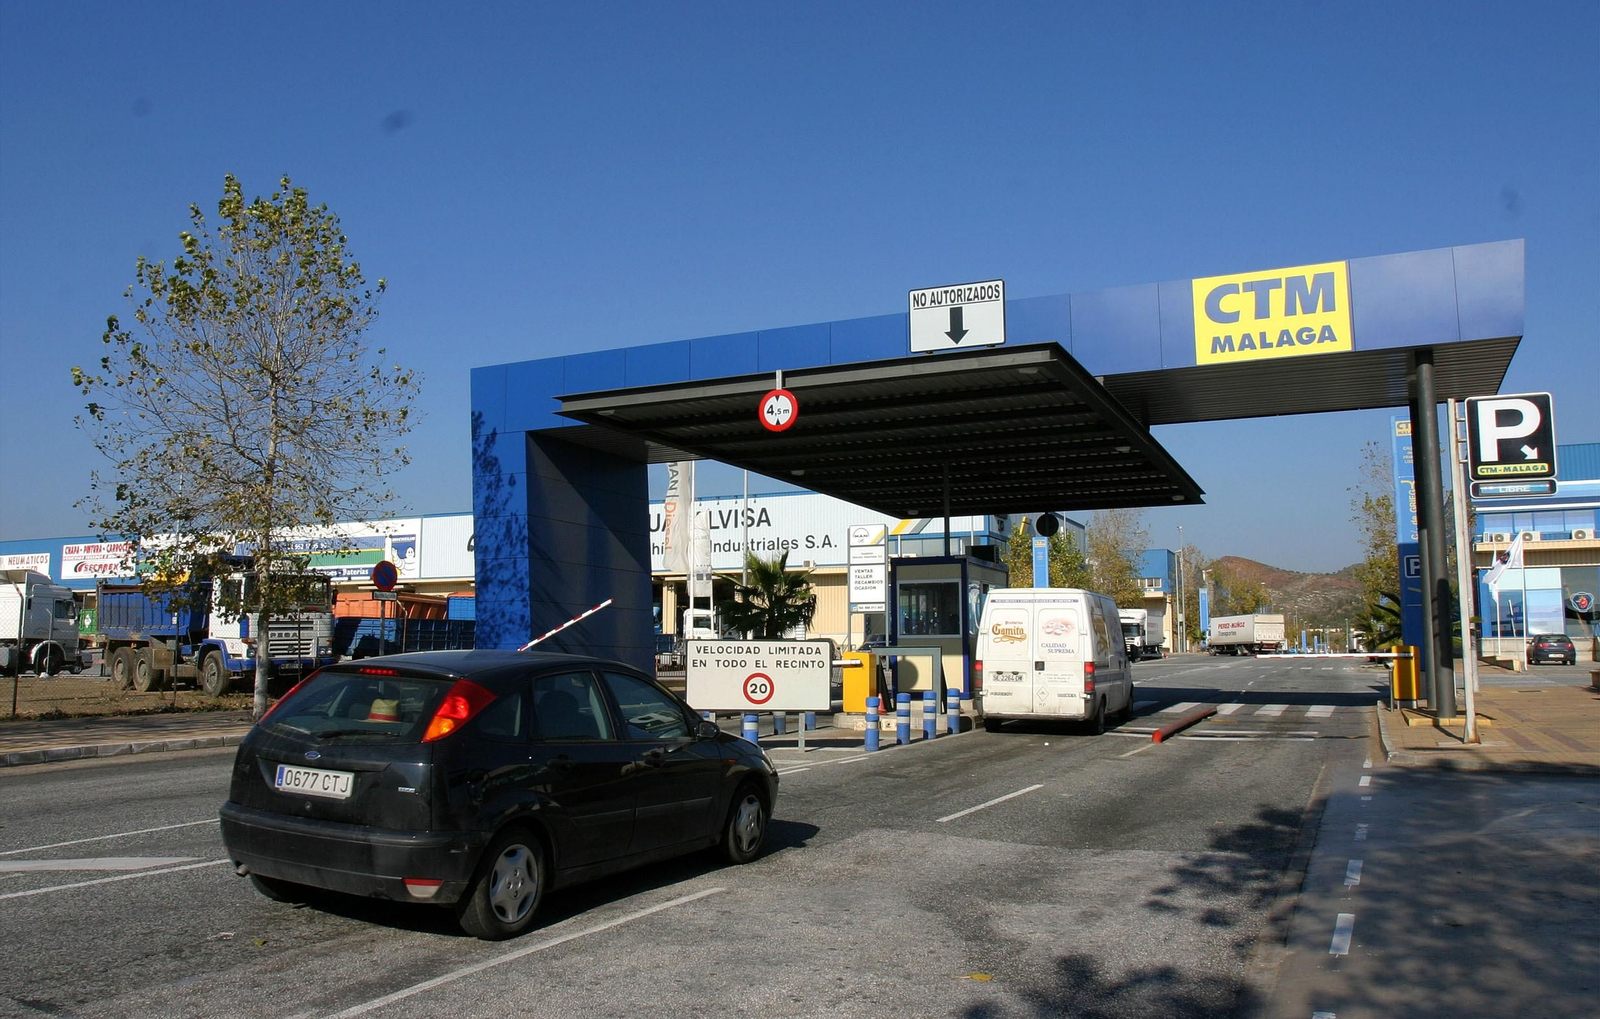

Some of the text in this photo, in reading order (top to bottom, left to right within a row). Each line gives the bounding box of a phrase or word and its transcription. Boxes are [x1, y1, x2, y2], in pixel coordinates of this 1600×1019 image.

[912, 284, 1001, 308] NO AUTORIZADOS
[1204, 272, 1336, 324] CTM
[1210, 324, 1338, 354] MALAGA
[1396, 421, 1411, 430] CT
[1477, 398, 1541, 462] P
[805, 533, 838, 549] S.A.
[8, 555, 49, 566] NEUMATICOS
[1409, 558, 1421, 575] P
[696, 645, 822, 655] VELOCIDAD LIMITADA
[692, 659, 825, 669] EN TODO EL RECINTO
[749, 683, 768, 694] 20
[284, 769, 320, 789] 0677
[321, 773, 350, 794] CTJ
